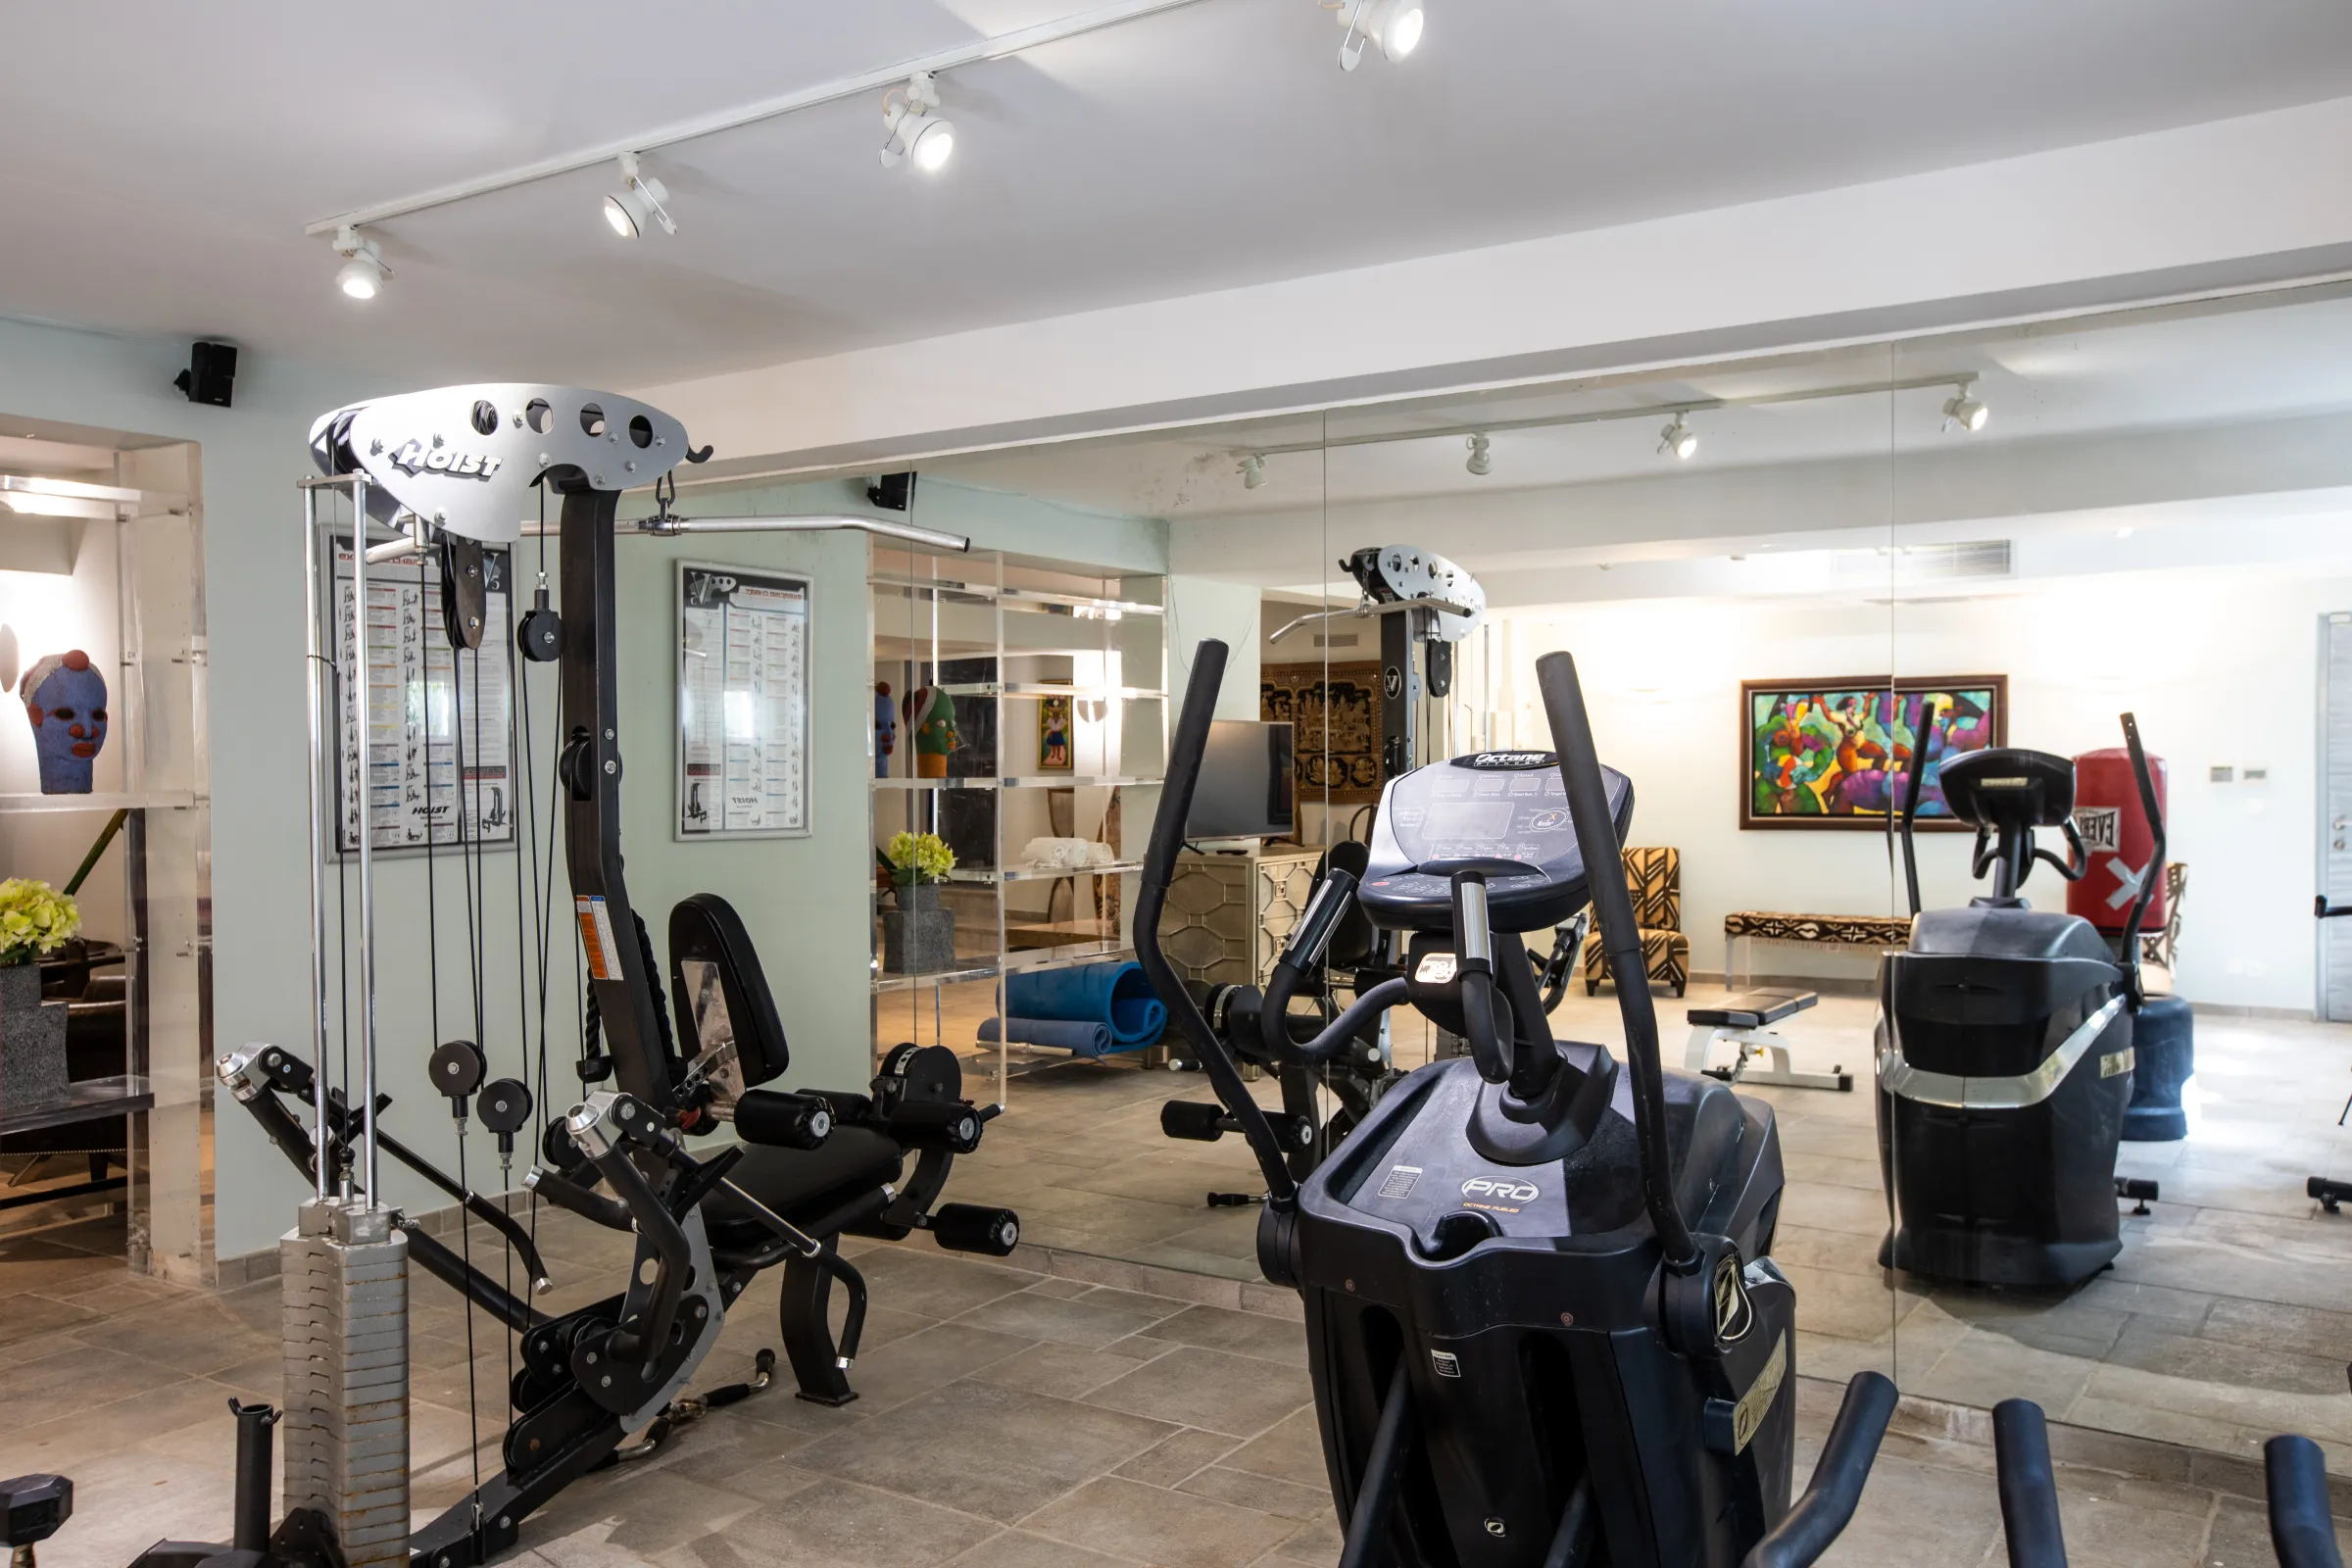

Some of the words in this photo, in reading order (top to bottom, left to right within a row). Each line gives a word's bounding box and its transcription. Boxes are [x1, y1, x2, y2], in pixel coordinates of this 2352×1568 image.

[397, 443, 504, 477] HOIST
[1474, 753, 1546, 762] Octane
[412, 806, 450, 815] HOIST
[1464, 1179, 1536, 1201] PRO
[1462, 1201, 1491, 1210] OCTANE
